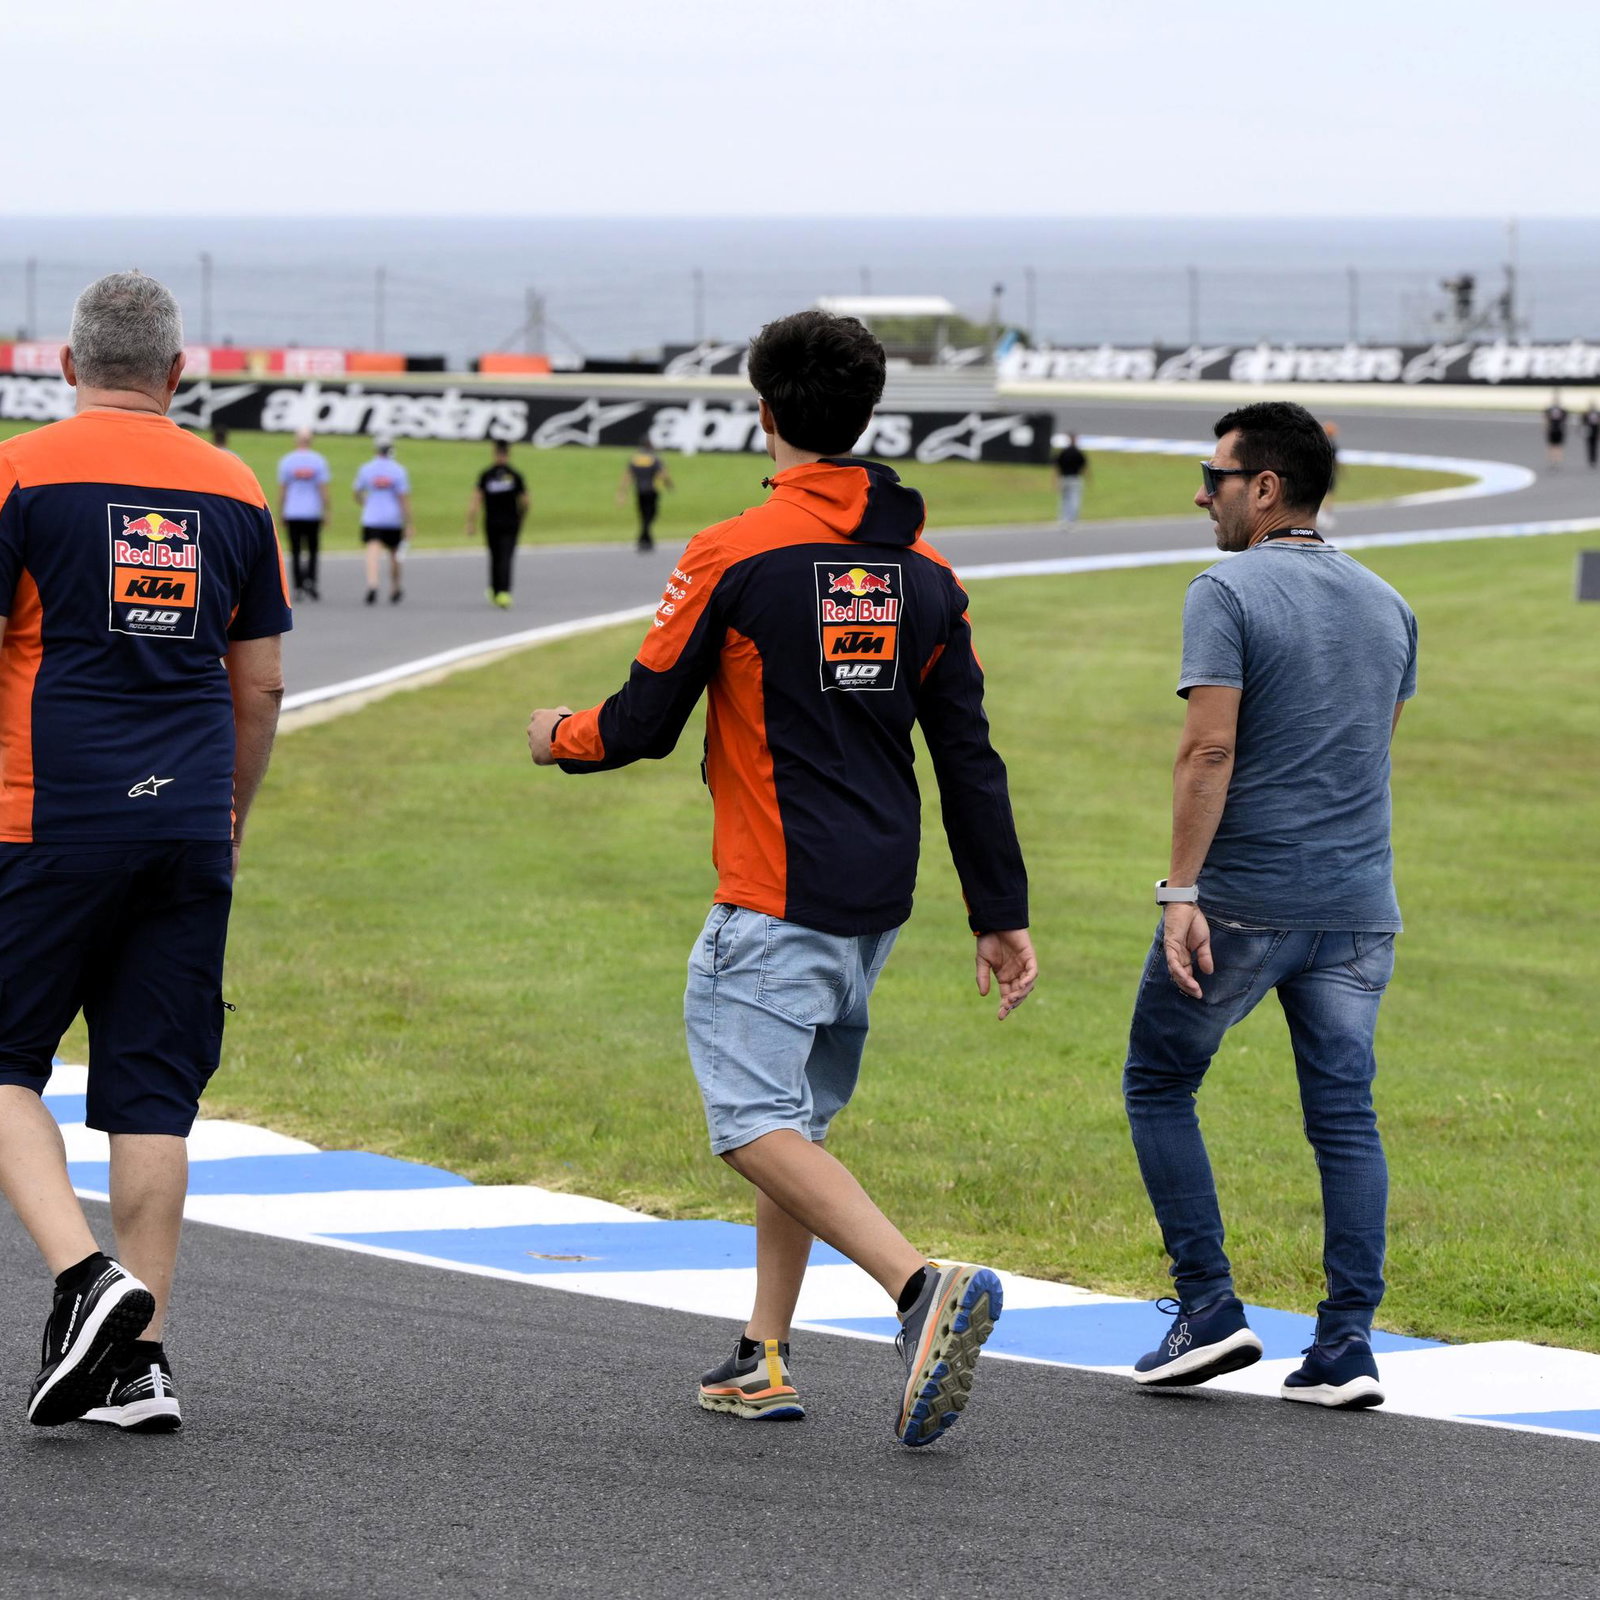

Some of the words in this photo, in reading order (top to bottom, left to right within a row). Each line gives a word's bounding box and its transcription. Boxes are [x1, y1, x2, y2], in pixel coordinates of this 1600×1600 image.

[261, 382, 528, 440] alpinestars
[114, 540, 156, 566] Red
[156, 543, 197, 569] Bull
[125, 576, 186, 600] KTM
[126, 608, 182, 624] AJO
[822, 598, 859, 622] Red
[858, 598, 898, 622] Bull
[832, 632, 885, 654] KTM
[835, 664, 882, 680] AJO
[61, 1293, 82, 1354] alpinestars
